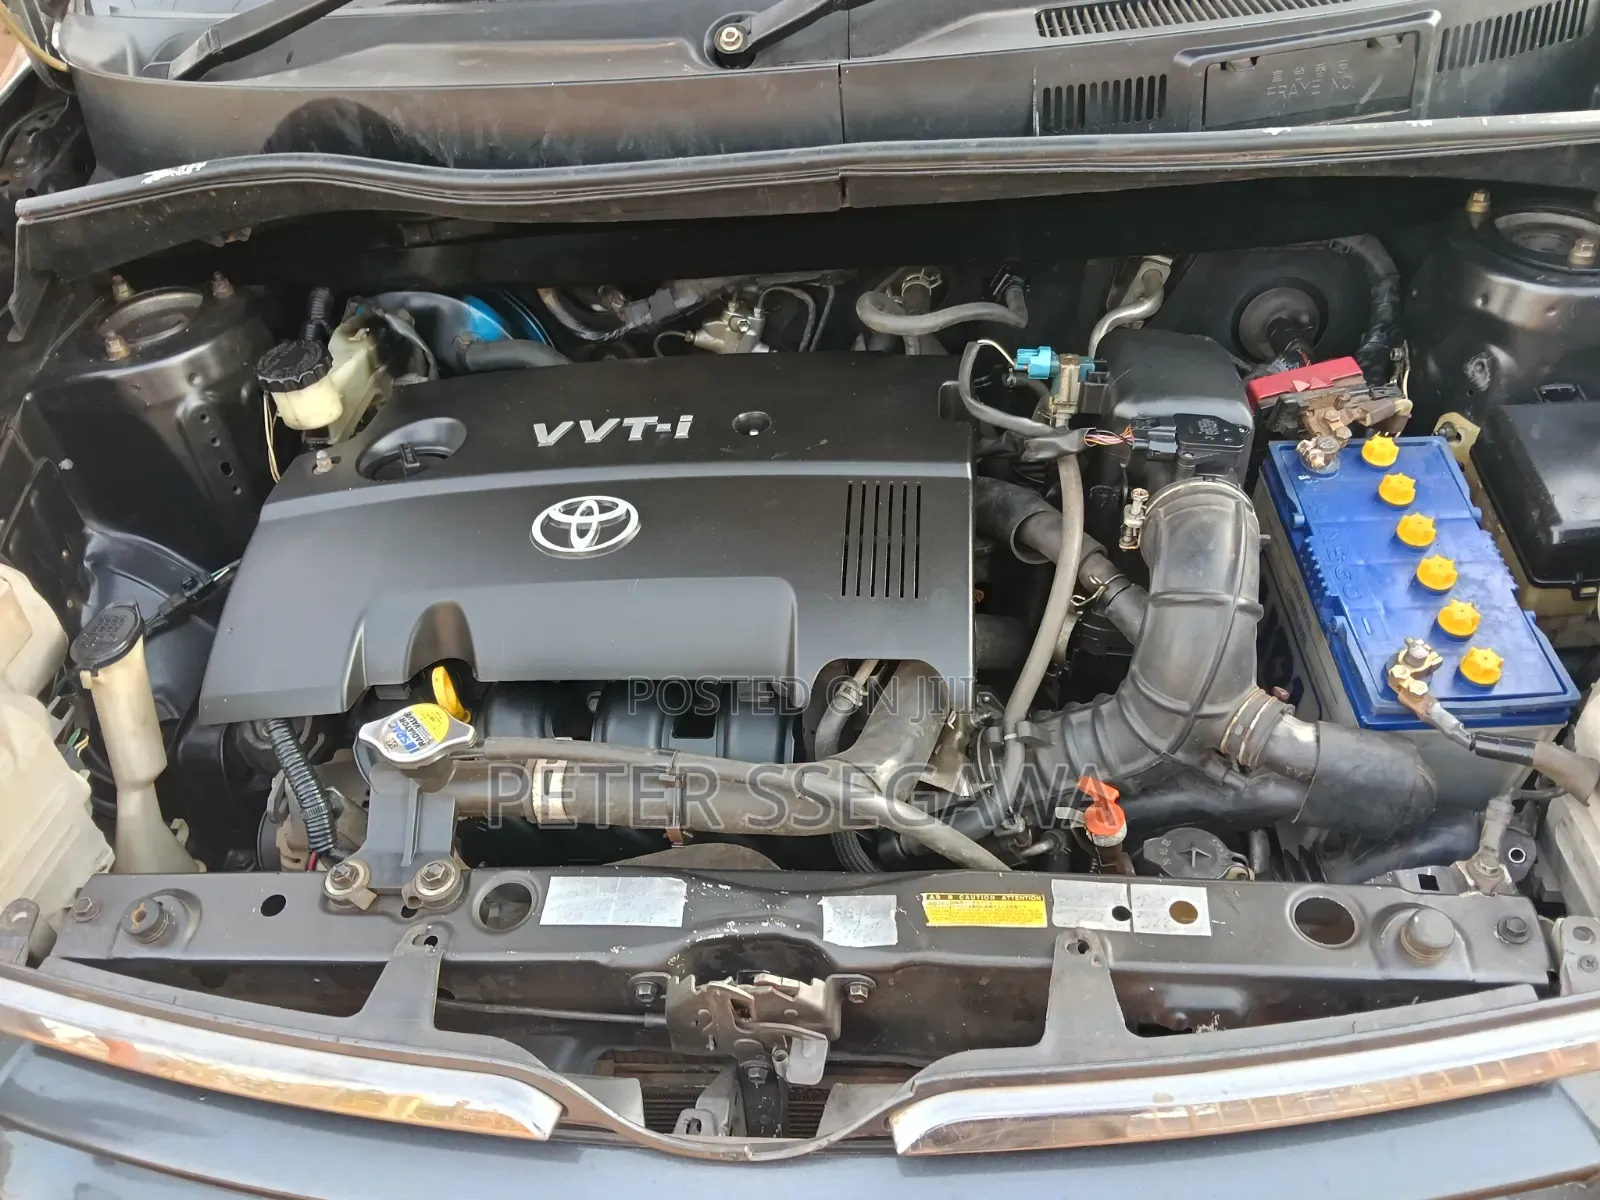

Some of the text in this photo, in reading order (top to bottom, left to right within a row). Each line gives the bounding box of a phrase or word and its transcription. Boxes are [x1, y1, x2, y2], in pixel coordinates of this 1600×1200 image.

[1265, 80, 1322, 98] FRAME
[533, 415, 693, 447] VVT-i
[399, 717, 427, 747] RADIATOR
